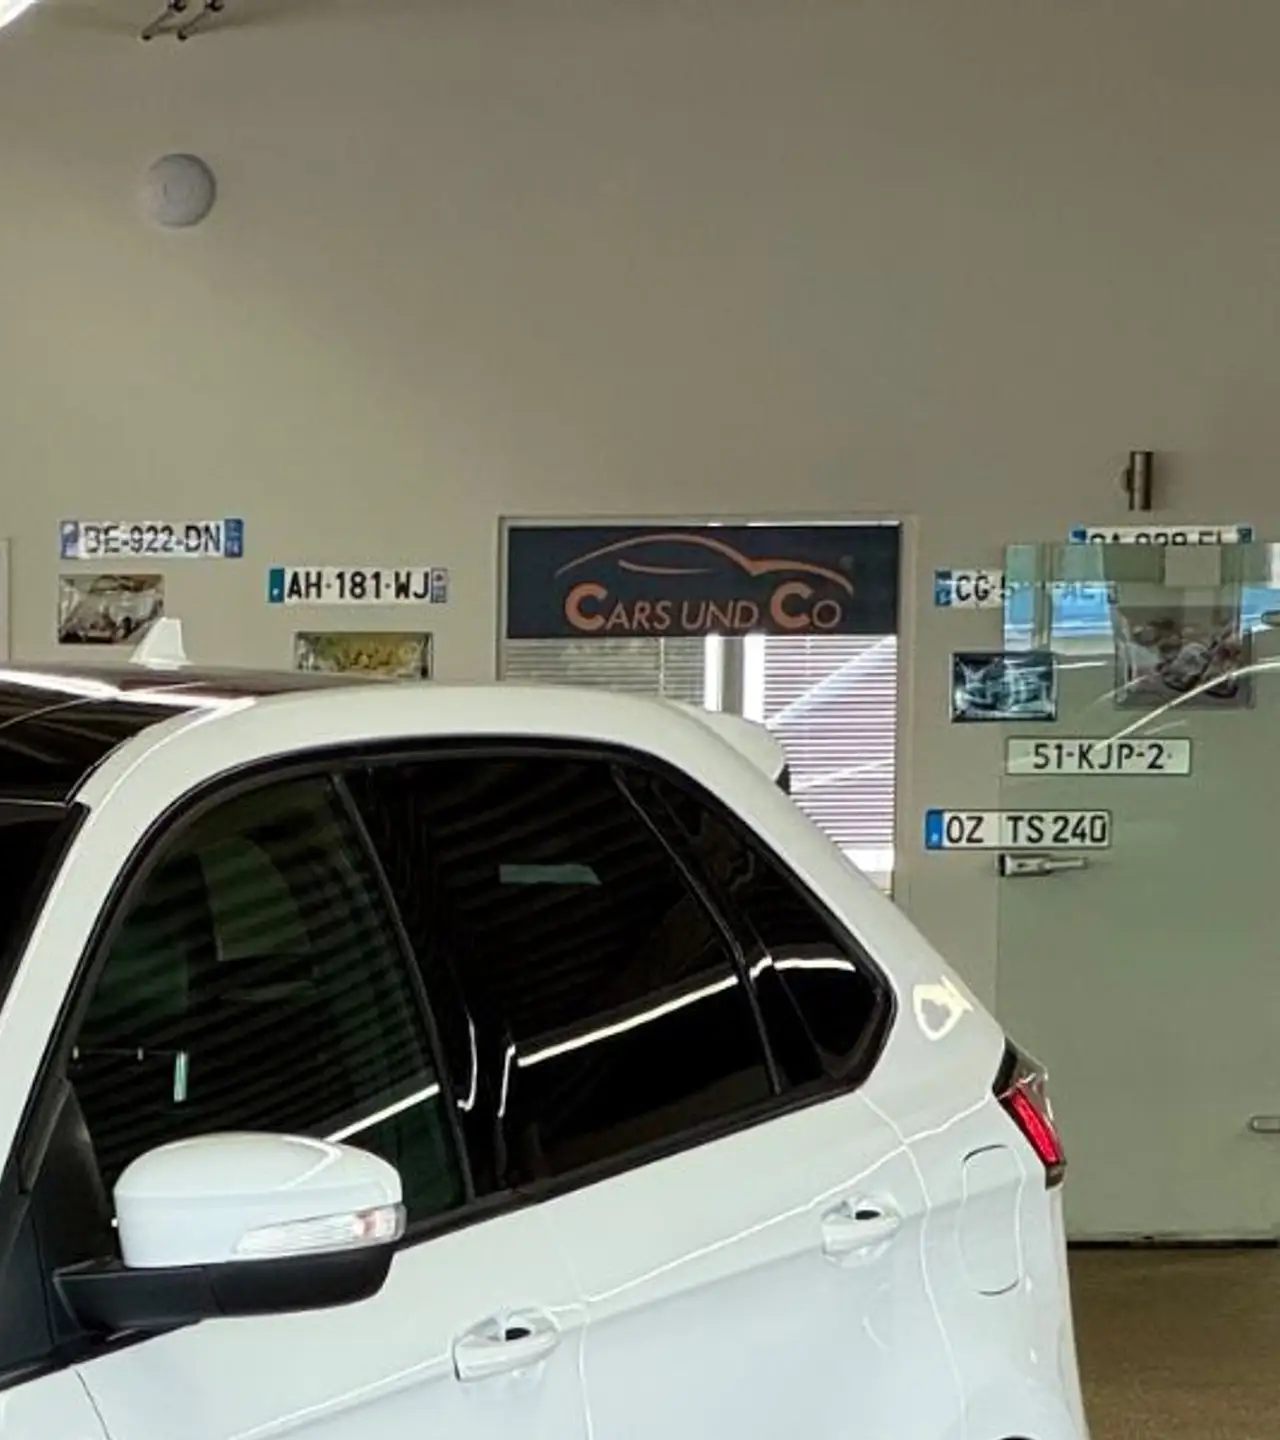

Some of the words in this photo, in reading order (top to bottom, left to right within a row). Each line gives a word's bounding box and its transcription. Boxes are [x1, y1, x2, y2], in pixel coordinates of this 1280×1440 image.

[286, 570, 430, 600] AH-181-WJ
[1033, 743, 1164, 770] 51-KJP-2
[1007, 815, 1044, 844] TS
[1052, 815, 1107, 844] 240
